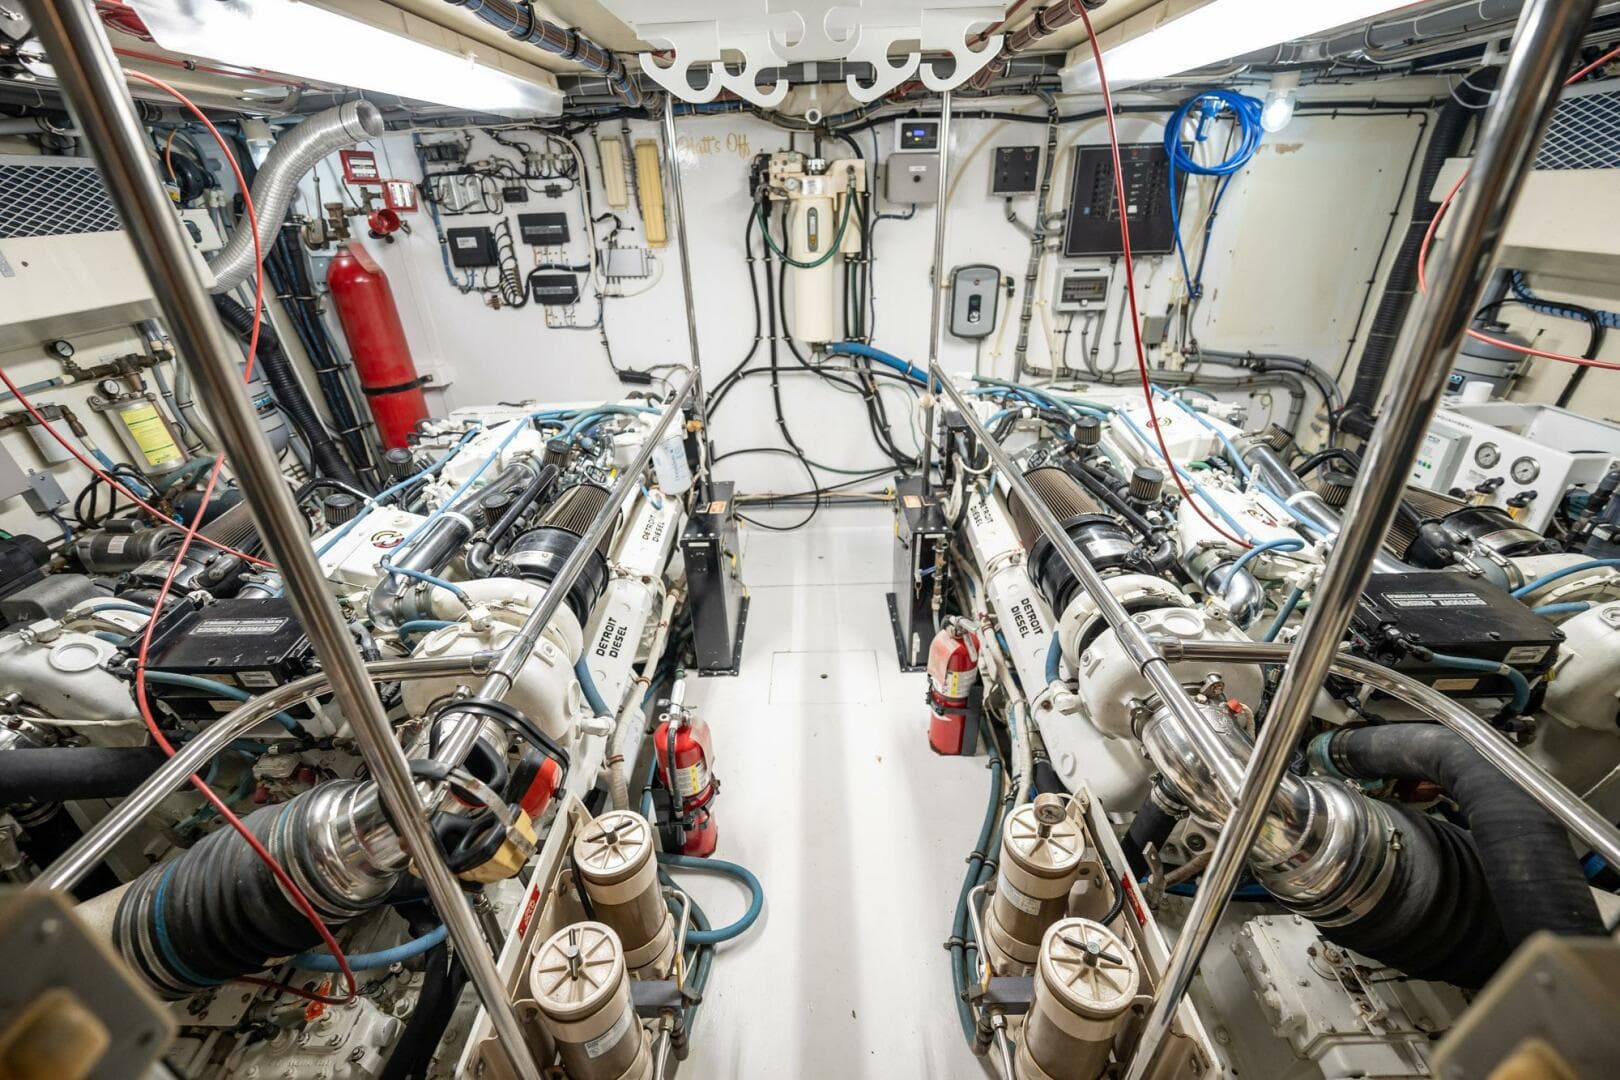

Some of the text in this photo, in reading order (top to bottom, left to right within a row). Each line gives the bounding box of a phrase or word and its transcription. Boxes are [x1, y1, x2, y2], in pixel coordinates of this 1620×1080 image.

[1010, 605, 1030, 639] DIESEL
[1020, 597, 1044, 635] DETROIT
[595, 616, 617, 657] DETROIT
[608, 626, 628, 658] DIESEL
